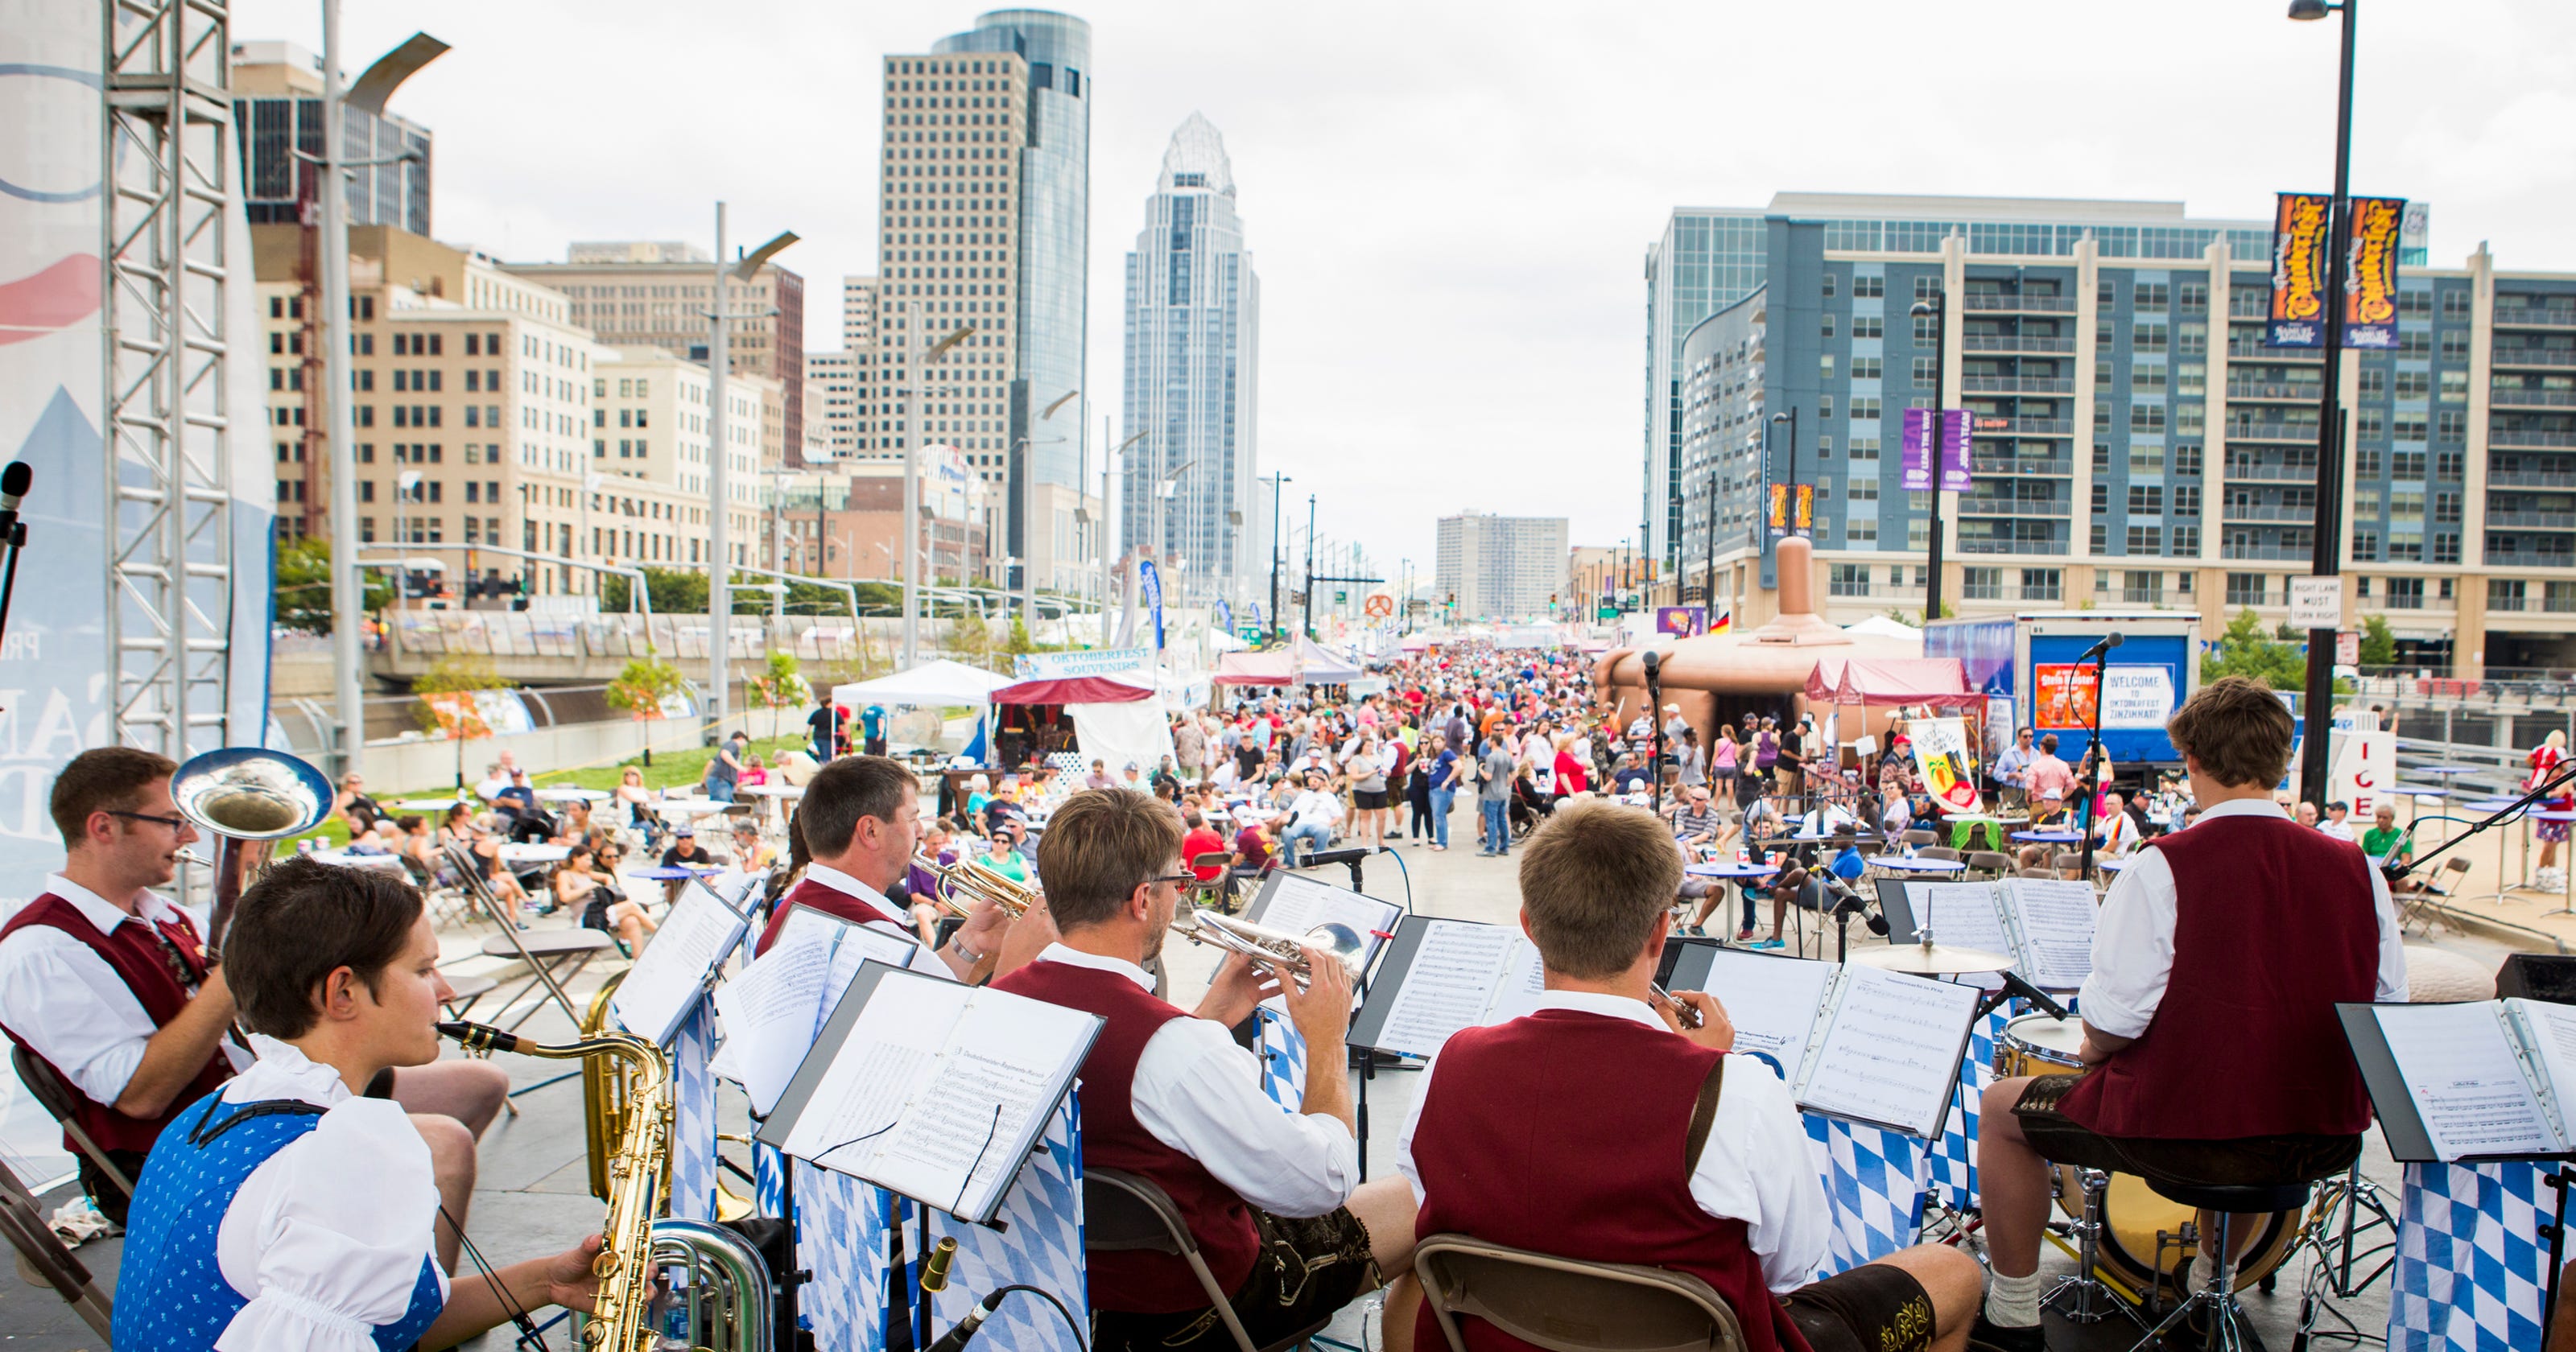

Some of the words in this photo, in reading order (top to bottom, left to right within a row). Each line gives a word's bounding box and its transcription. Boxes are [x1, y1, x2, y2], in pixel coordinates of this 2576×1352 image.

[1922, 410, 1931, 431] WAY
[1961, 412, 1971, 438] TEAM
[1922, 431, 1930, 447] THE
[1961, 438, 1969, 446] A
[1921, 448, 1930, 470] LEAD
[1960, 447, 1969, 469] JOIN
[2295, 584, 2317, 592] RIGHT
[2303, 596, 2329, 605] MUST
[1051, 647, 1149, 665] OKTOBERFEST
[1063, 661, 1140, 675] SOUVENIRS
[2109, 676, 2160, 688] WELCOME
[2109, 700, 2160, 708] OKTOBERFEST
[2355, 742, 2374, 816] ICE
